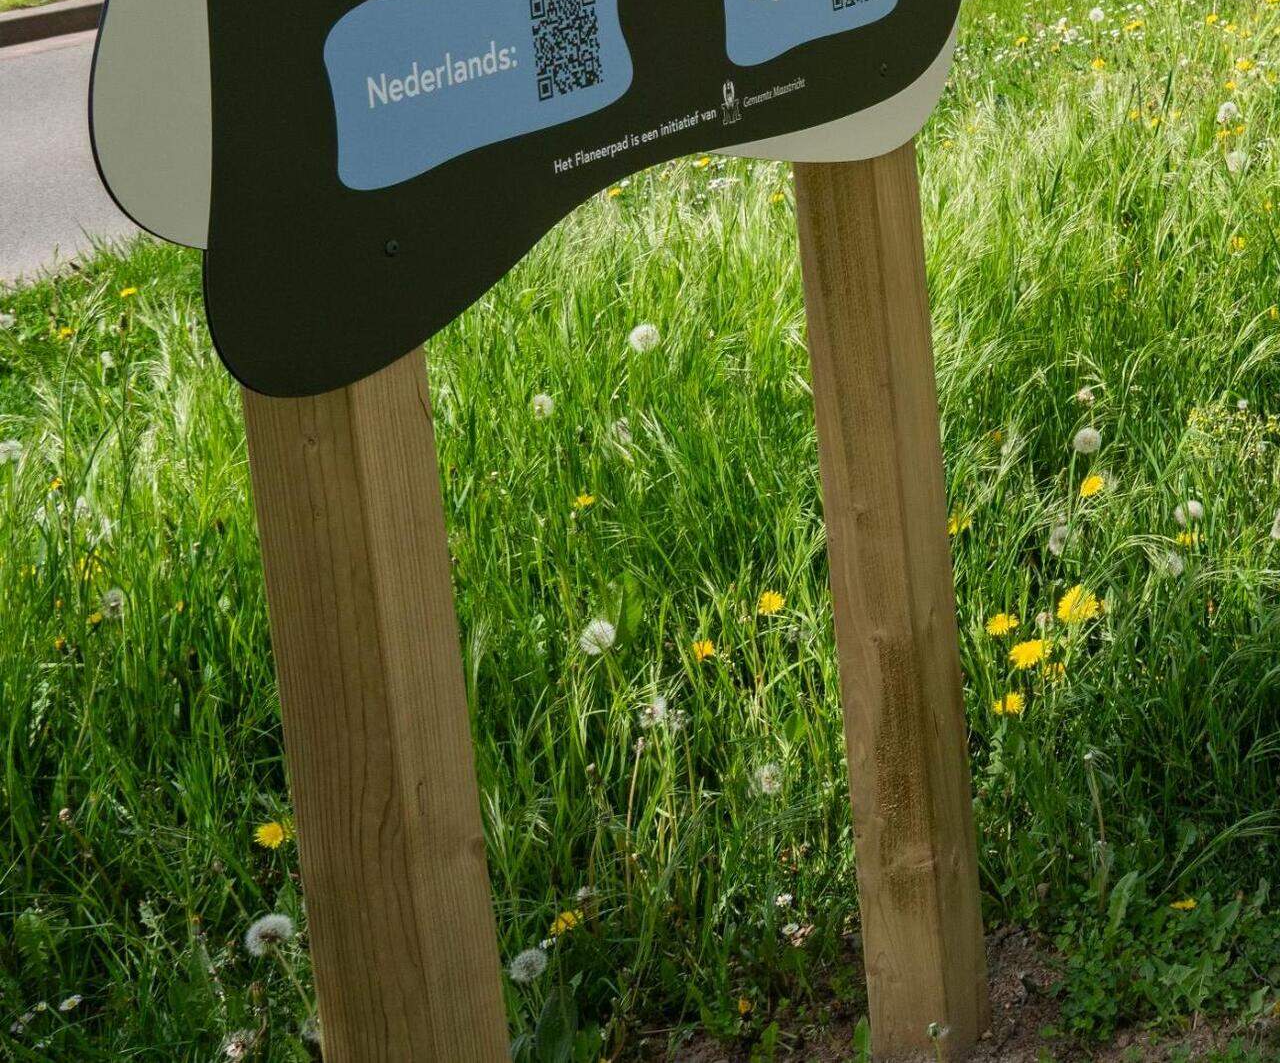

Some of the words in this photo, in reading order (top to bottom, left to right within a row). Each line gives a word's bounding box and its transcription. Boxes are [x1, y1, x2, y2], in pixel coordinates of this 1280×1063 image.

[367, 40, 518, 109] Nederlands:
[554, 158, 573, 174] Het
[575, 135, 629, 167] Flaneerpad
[631, 132, 640, 148] is
[641, 128, 659, 143] een
[660, 111, 700, 136] initiatief
[701, 108, 717, 121] van
